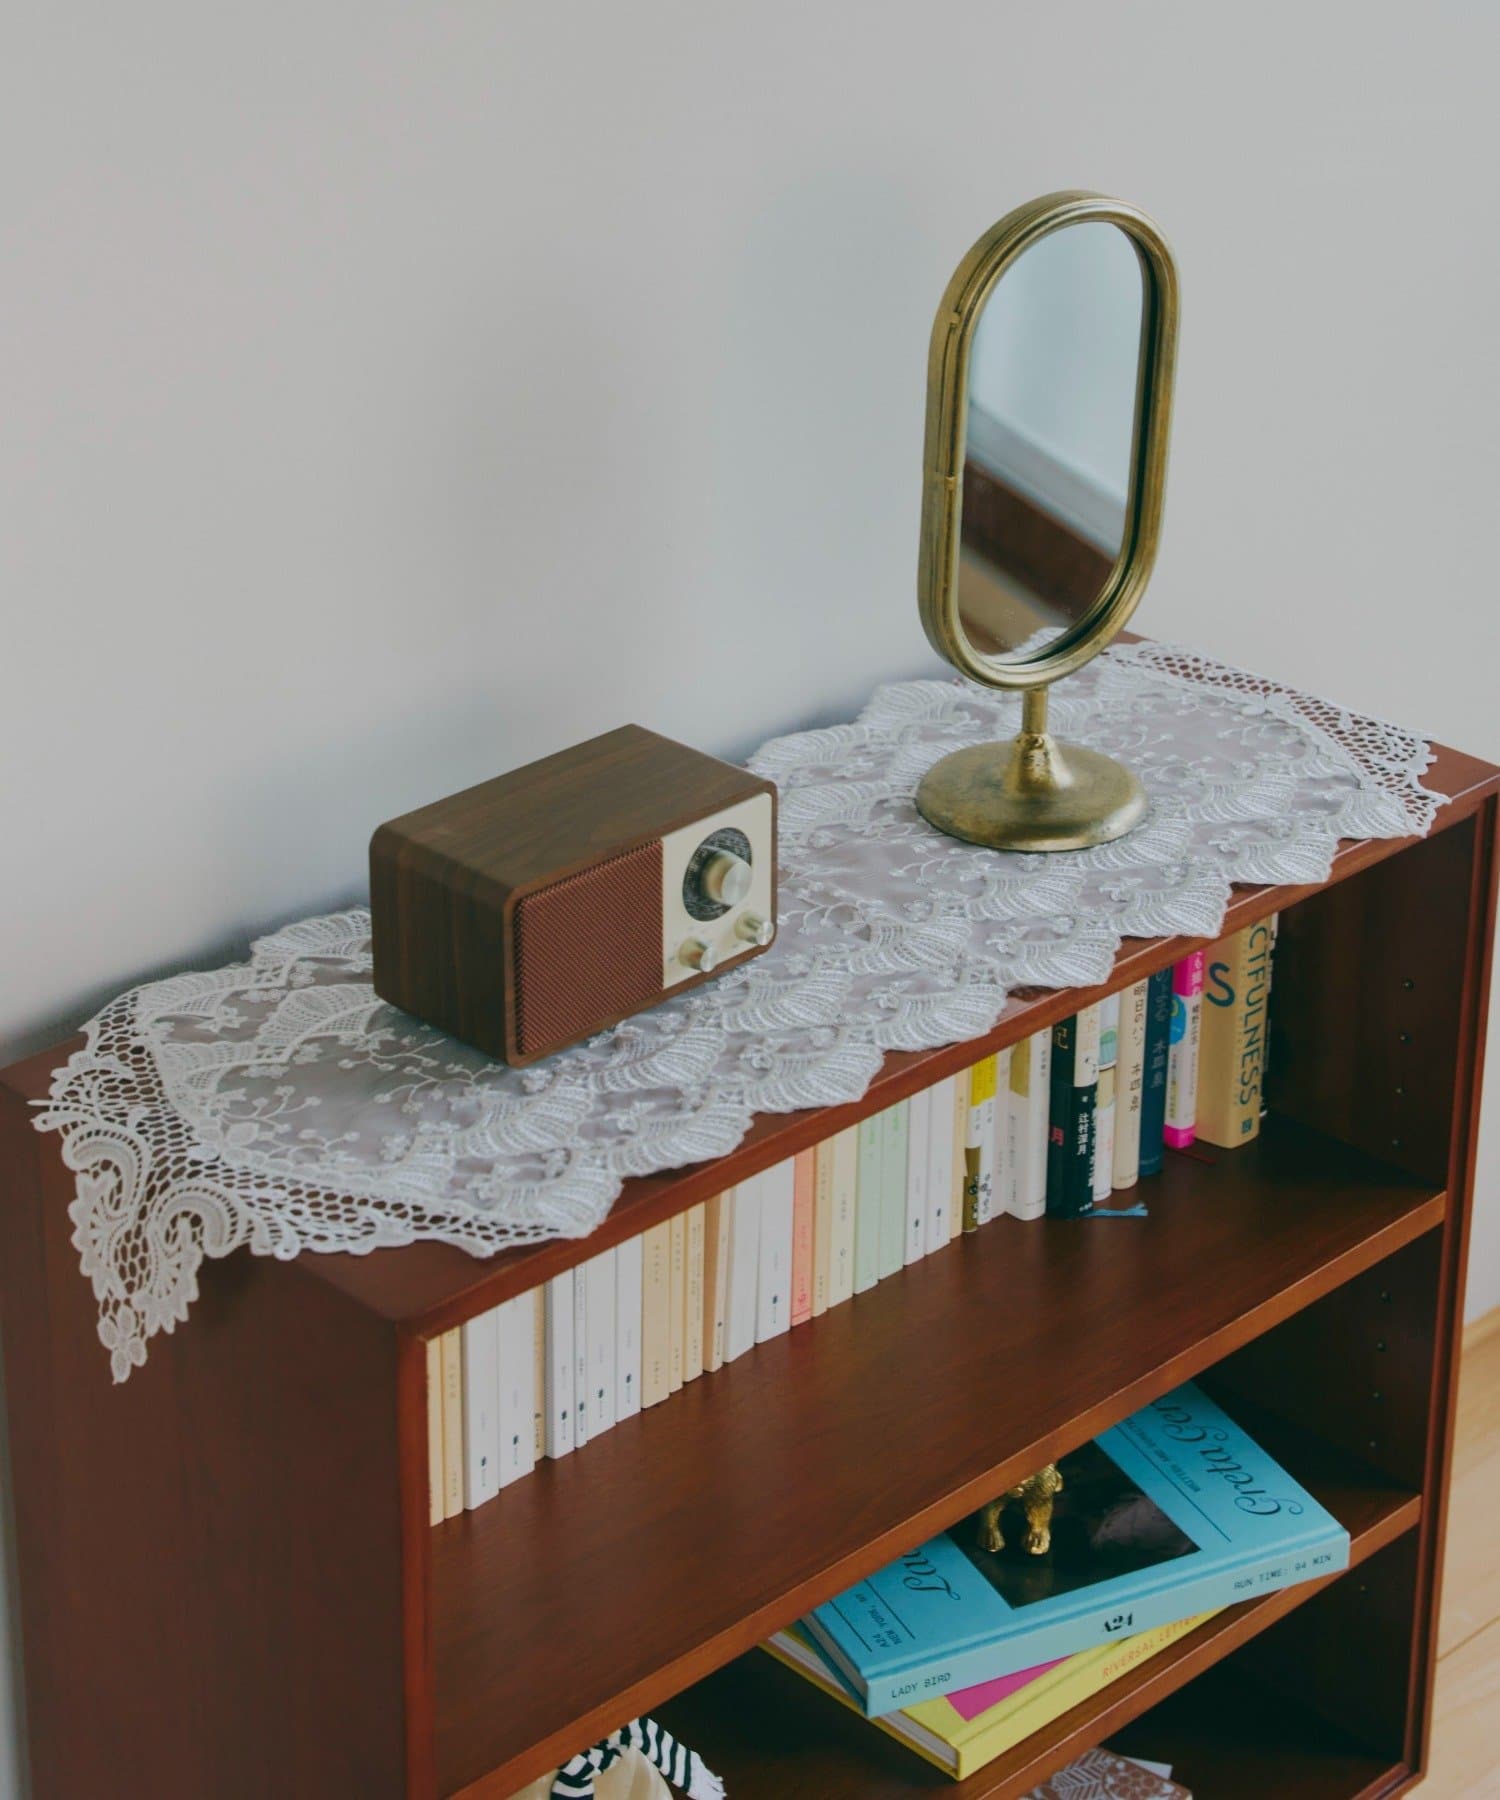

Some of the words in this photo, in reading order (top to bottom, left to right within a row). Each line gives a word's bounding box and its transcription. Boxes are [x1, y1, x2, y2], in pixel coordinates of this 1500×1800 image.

[1240, 924, 1268, 1105] CTFULNESS
[1150, 1401, 1229, 1442] Ger
[1199, 1443, 1305, 1515] Greta
[902, 1551, 962, 1601] La
[1233, 1578, 1253, 1590] RUN
[1312, 1553, 1332, 1567] MIN
[891, 1682, 918, 1698] LADY
[924, 1672, 951, 1688] BIRD
